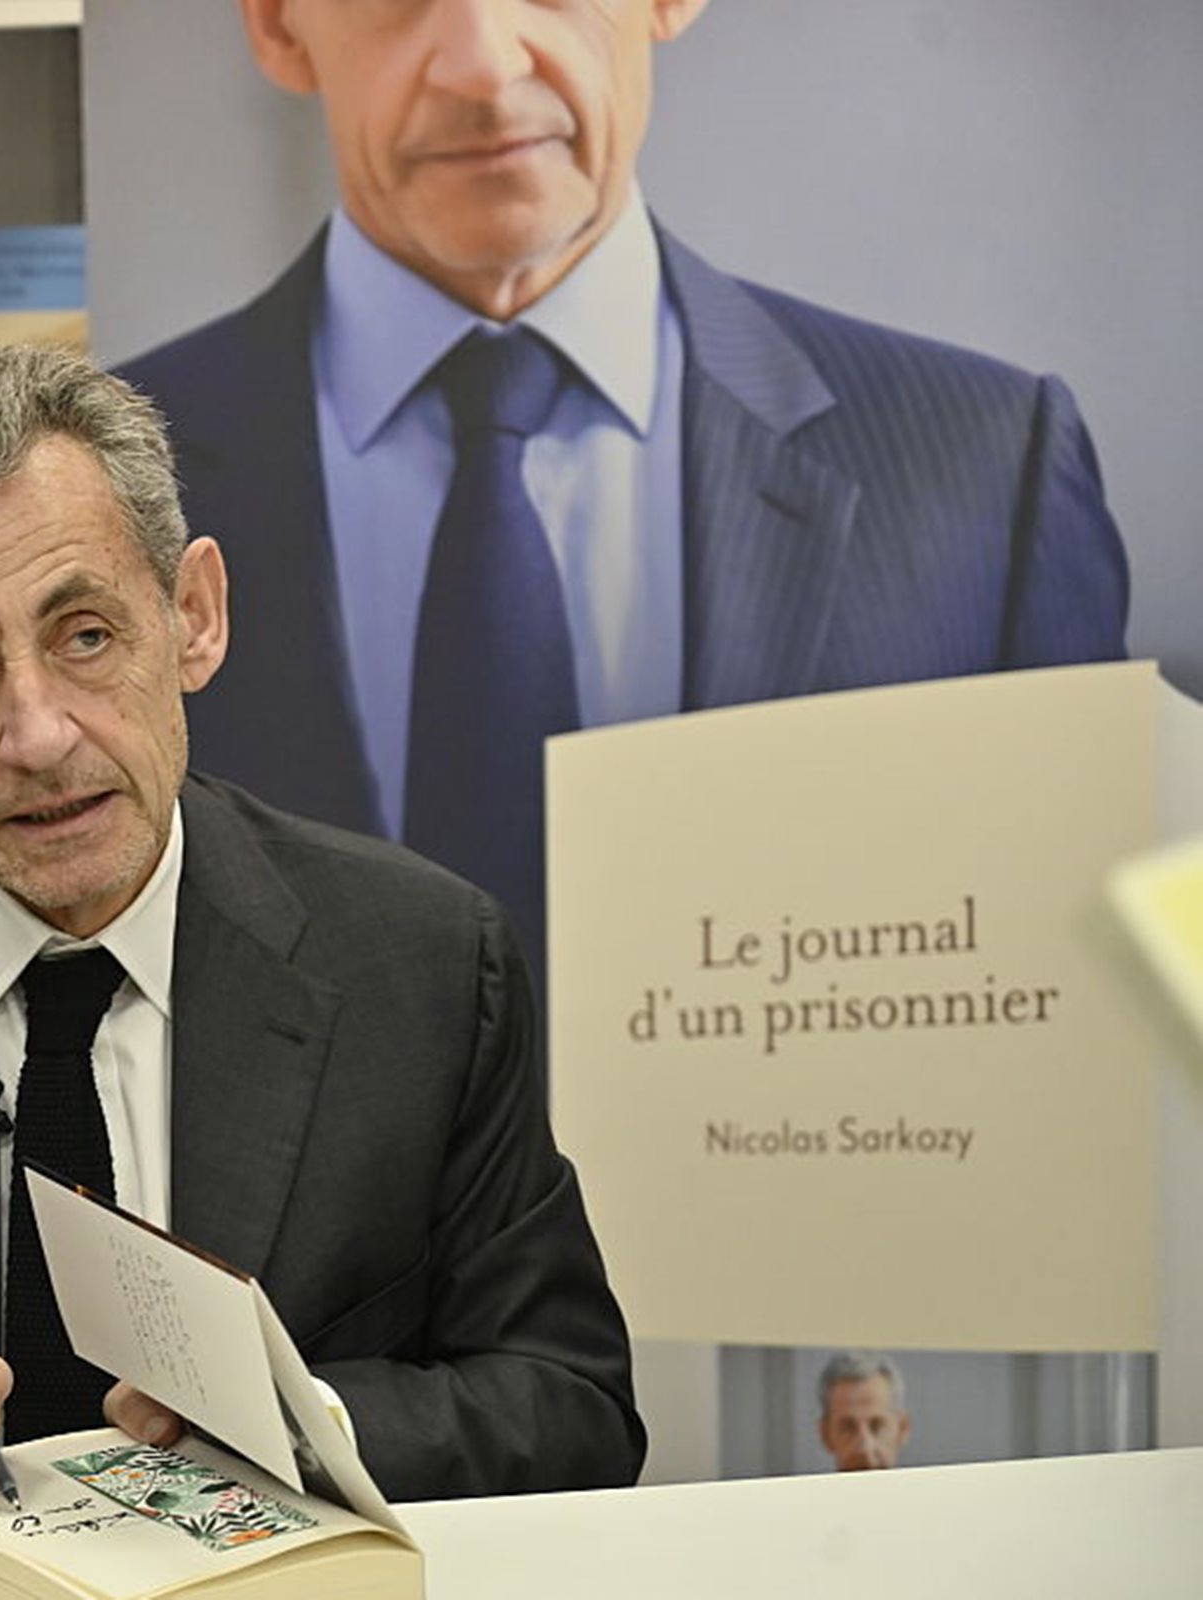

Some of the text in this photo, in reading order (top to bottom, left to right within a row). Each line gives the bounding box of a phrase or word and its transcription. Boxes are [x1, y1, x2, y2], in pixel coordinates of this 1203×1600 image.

[699, 894, 978, 986] Le journal
[626, 973, 1061, 1057] d'un prisonnier
[704, 1115, 974, 1161] Nicolas Sarkozy
